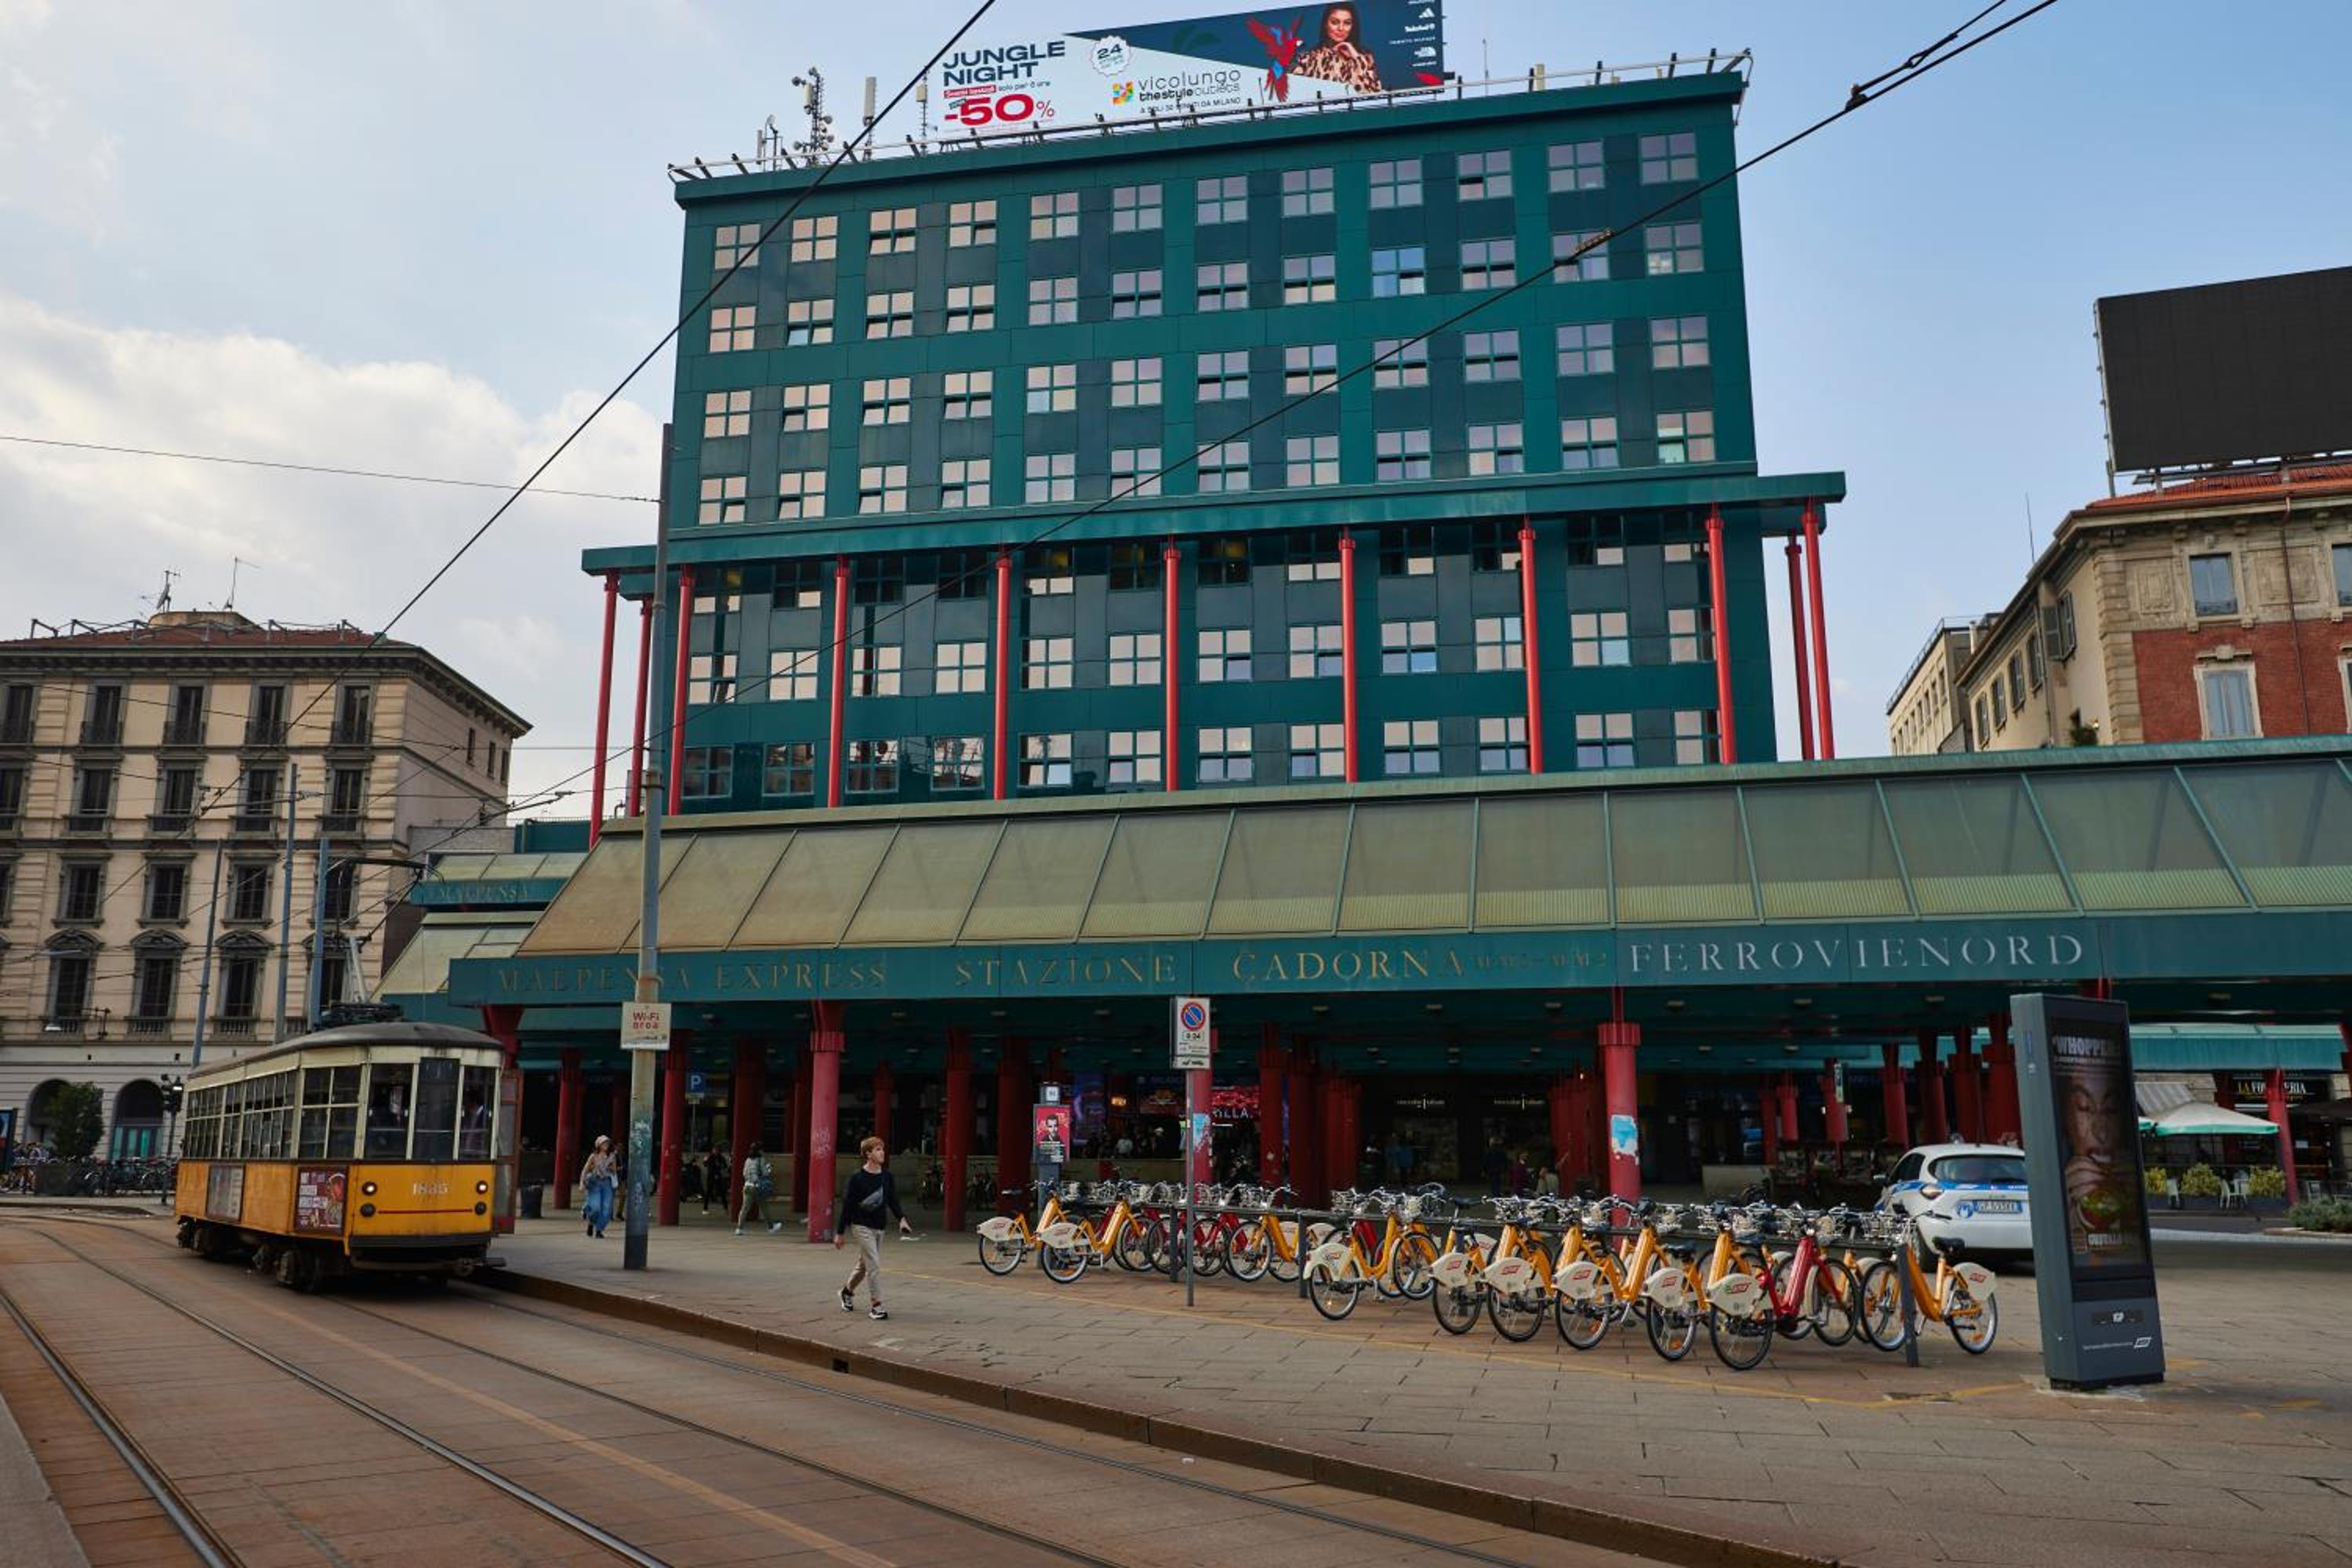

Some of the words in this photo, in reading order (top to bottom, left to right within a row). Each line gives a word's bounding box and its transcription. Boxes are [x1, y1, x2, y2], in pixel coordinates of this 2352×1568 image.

[942, 41, 1065, 69] JUNGLE
[1098, 43, 1123, 59] 24
[943, 61, 1039, 86] NIGHT
[1138, 70, 1240, 91] vicolungo
[945, 94, 1054, 125] -50%
[1213, 97, 1240, 107] MILANO
[1630, 935, 2082, 972] FERROVIENORD
[714, 963, 887, 990] EXPRESS
[955, 955, 1175, 986] STAZIONE
[1232, 949, 1464, 981] CADORNA
[633, 1011, 660, 1021] Wi-Fi
[691, 1075, 702, 1091] P
